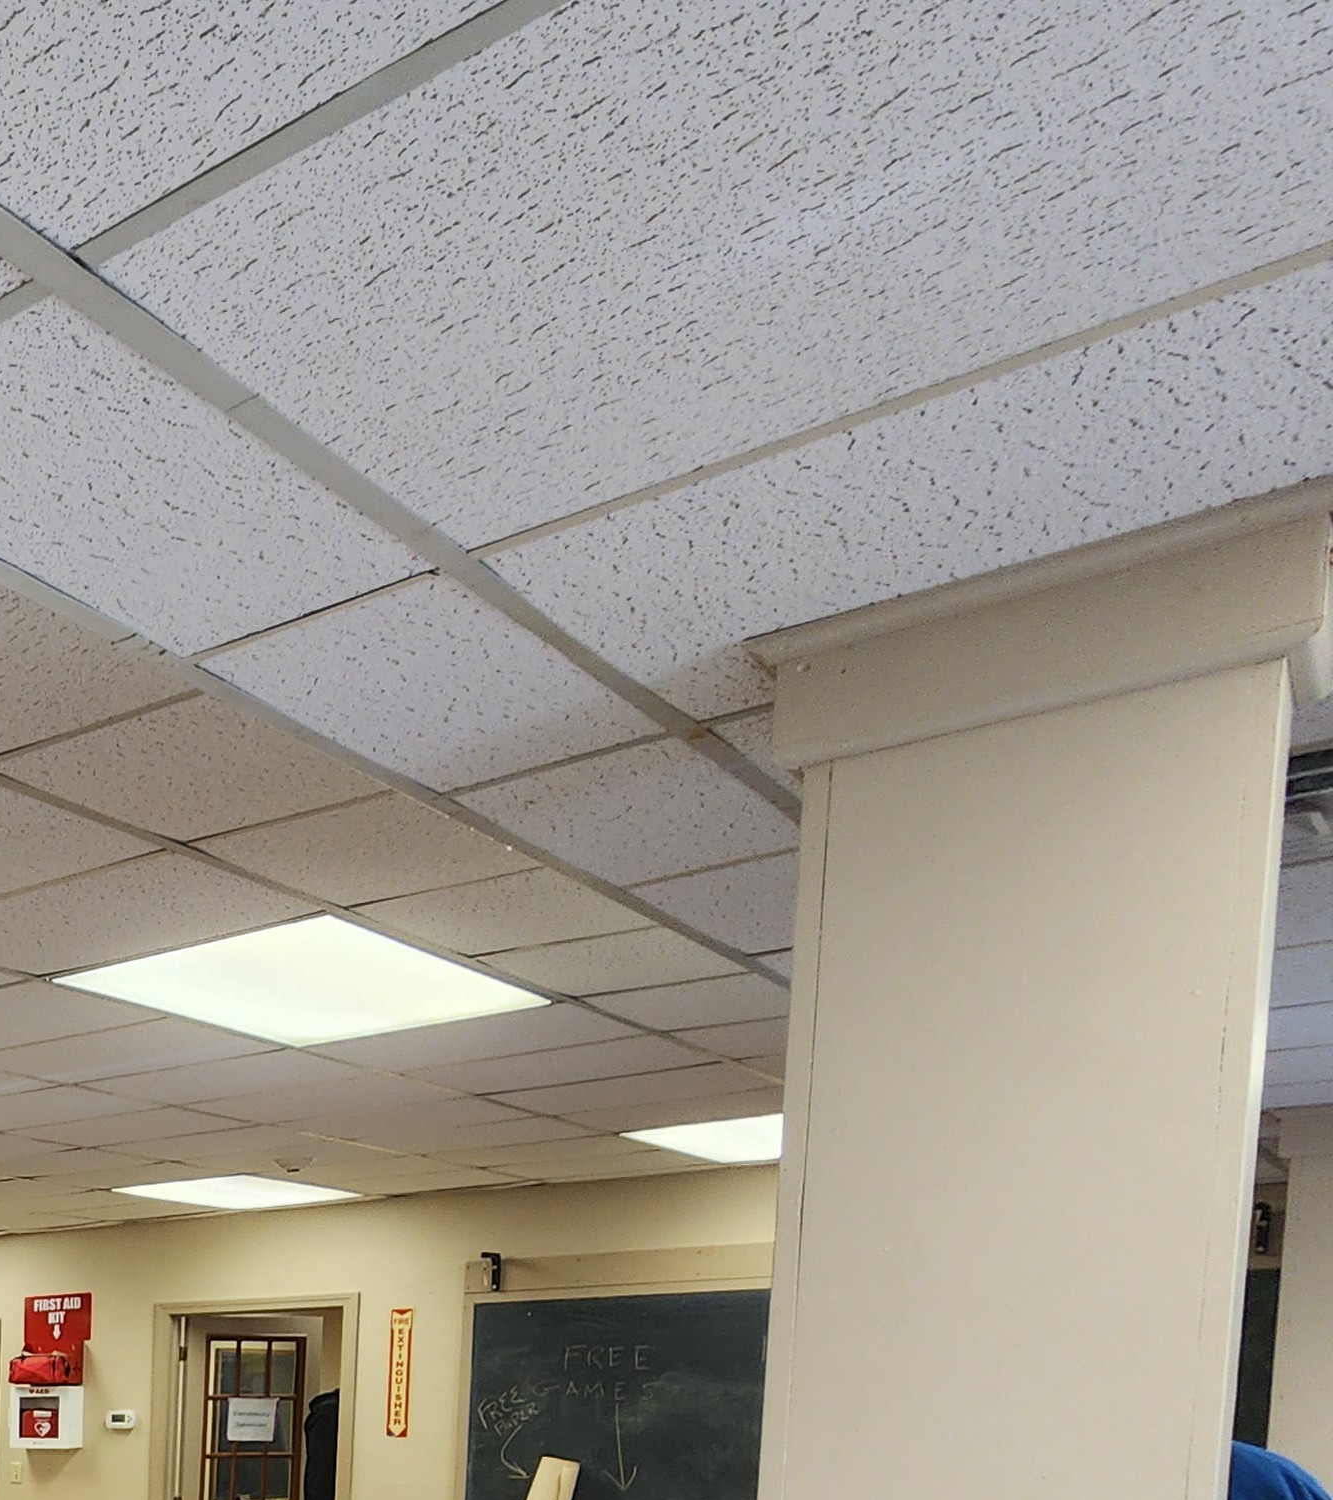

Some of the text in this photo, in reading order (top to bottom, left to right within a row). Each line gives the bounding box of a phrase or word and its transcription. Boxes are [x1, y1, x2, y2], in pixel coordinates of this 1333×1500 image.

[34, 1297, 81, 1312] FIRST AID
[48, 1311, 66, 1324] KIT
[563, 1345, 652, 1371] FREE
[393, 1328, 404, 1425] EXTINGUISHER
[533, 1380, 660, 1401] GAMES
[477, 1384, 525, 1431] FREE
